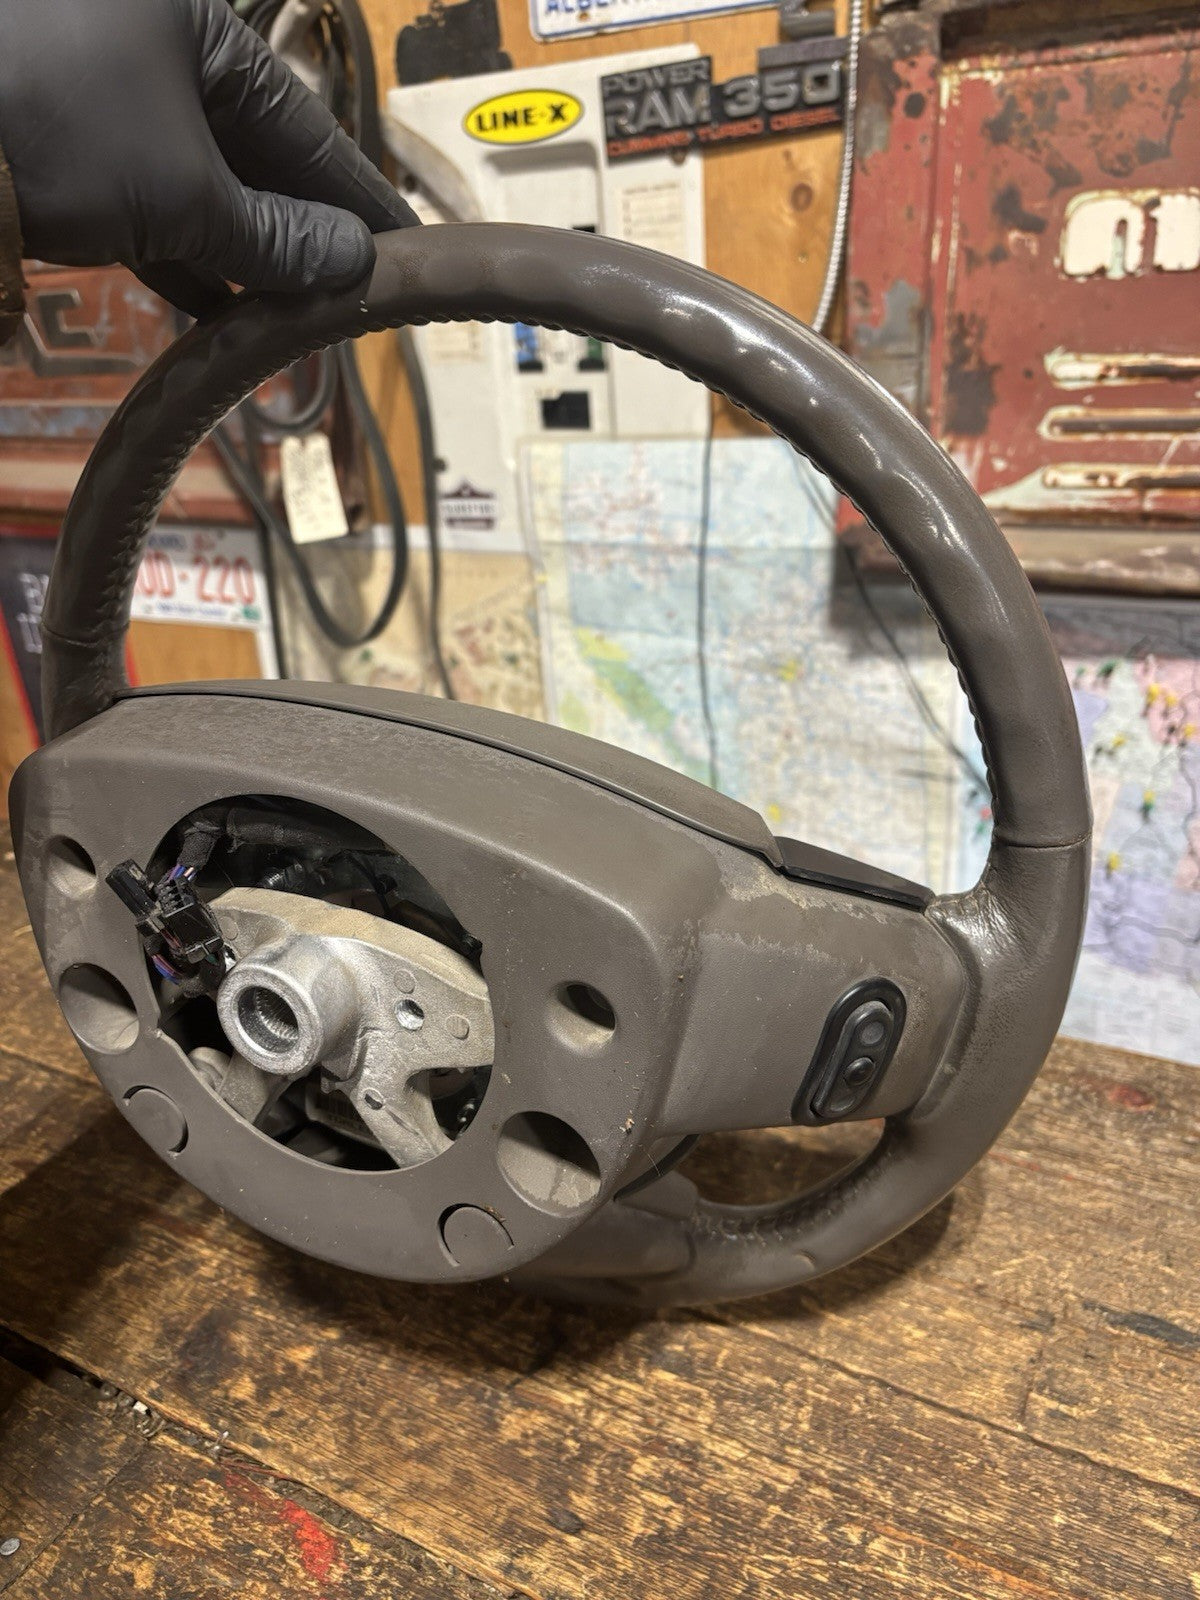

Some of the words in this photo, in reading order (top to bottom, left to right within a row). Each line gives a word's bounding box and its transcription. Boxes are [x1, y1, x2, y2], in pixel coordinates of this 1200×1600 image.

[603, 59, 711, 96] POWER
[604, 83, 712, 136] RAM
[722, 60, 843, 119] 350
[476, 103, 567, 132] LINE-X
